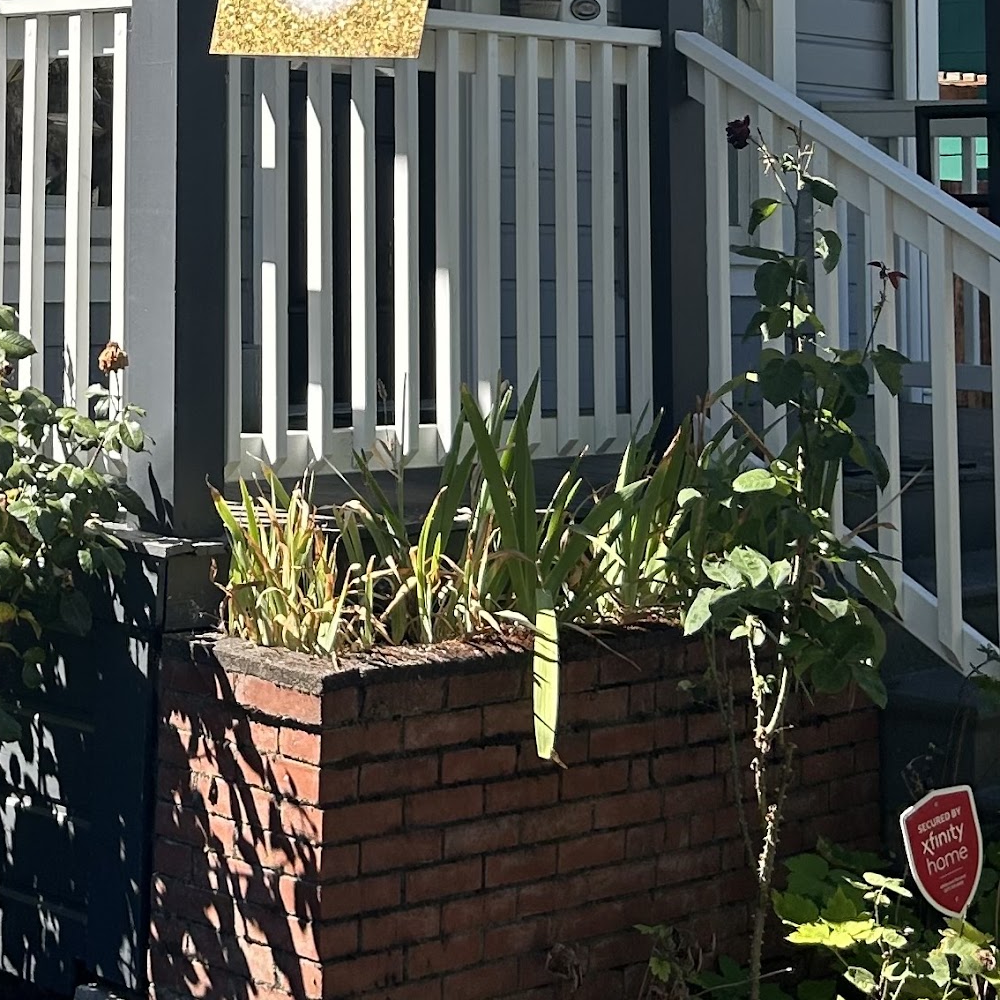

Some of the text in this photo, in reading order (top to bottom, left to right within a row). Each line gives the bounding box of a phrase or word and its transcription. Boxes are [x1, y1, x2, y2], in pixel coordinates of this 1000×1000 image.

[917, 806, 961, 834] SECURED BY
[920, 822, 964, 856] xfinity
[925, 845, 969, 876] home
